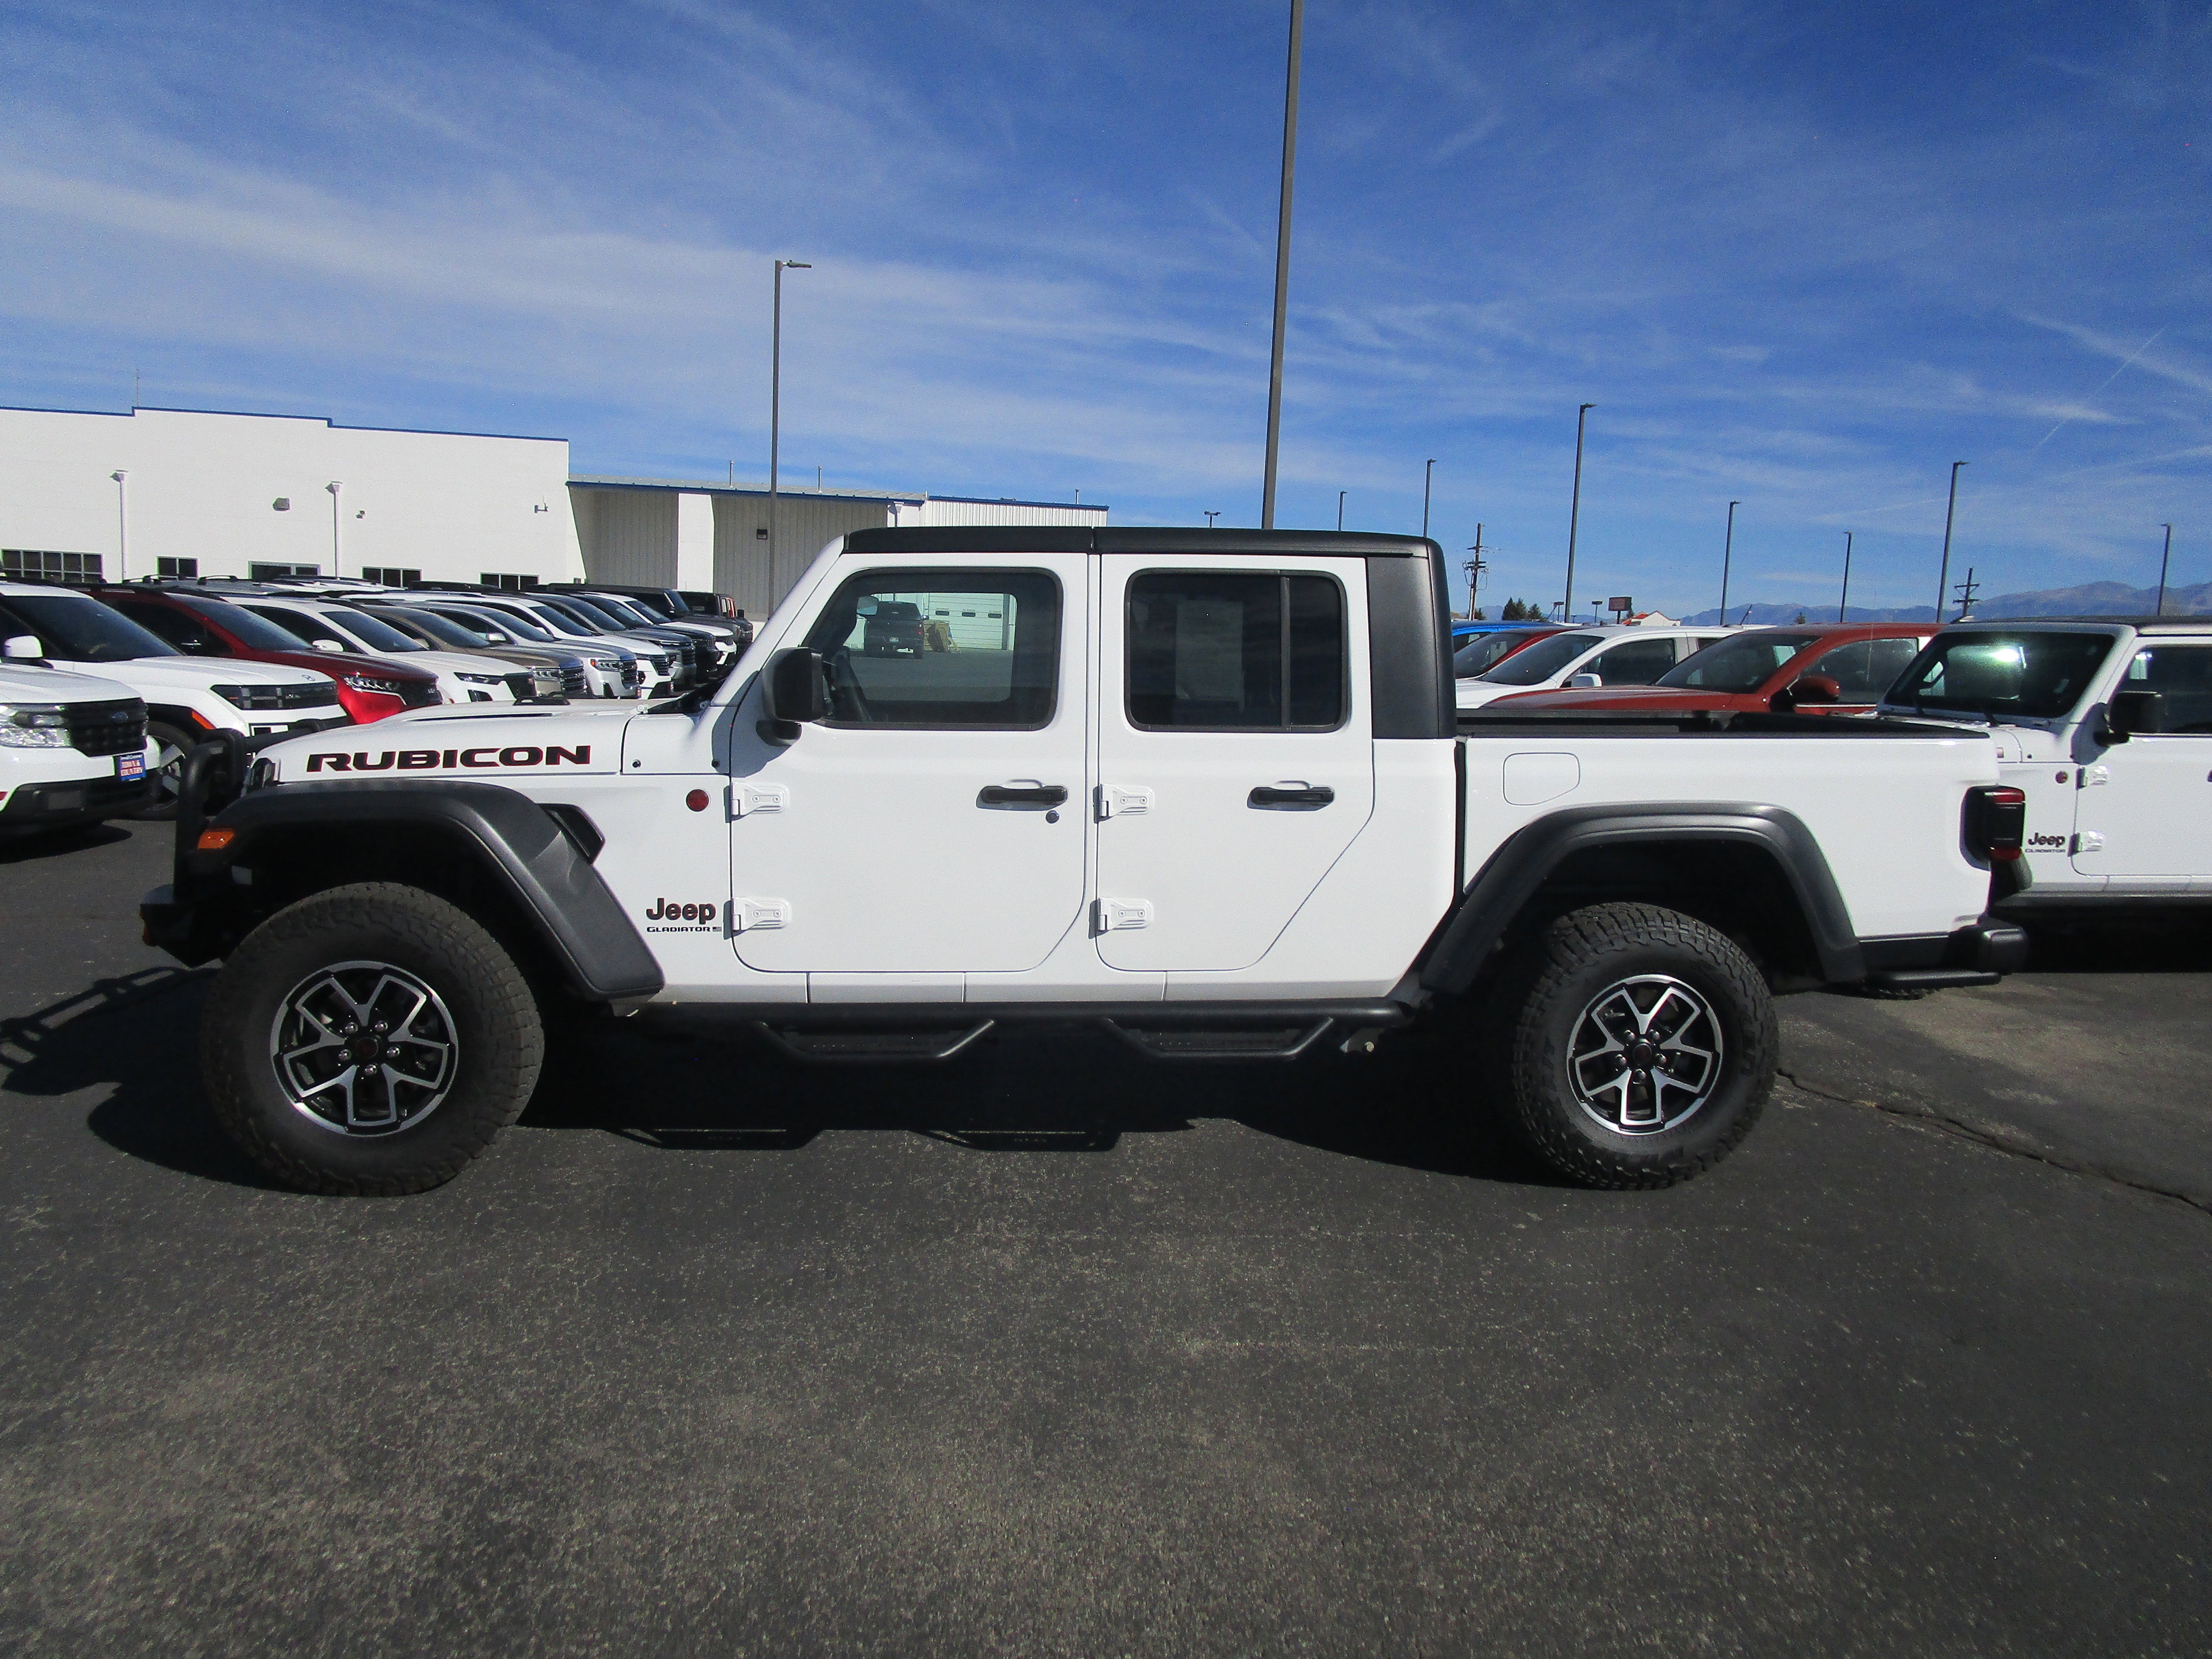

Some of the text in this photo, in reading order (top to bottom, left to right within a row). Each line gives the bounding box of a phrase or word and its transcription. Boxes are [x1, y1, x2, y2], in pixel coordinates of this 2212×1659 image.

[307, 745, 591, 772] RUBICON
[2027, 832, 2066, 848] Jeep
[646, 897, 717, 925] Jeep
